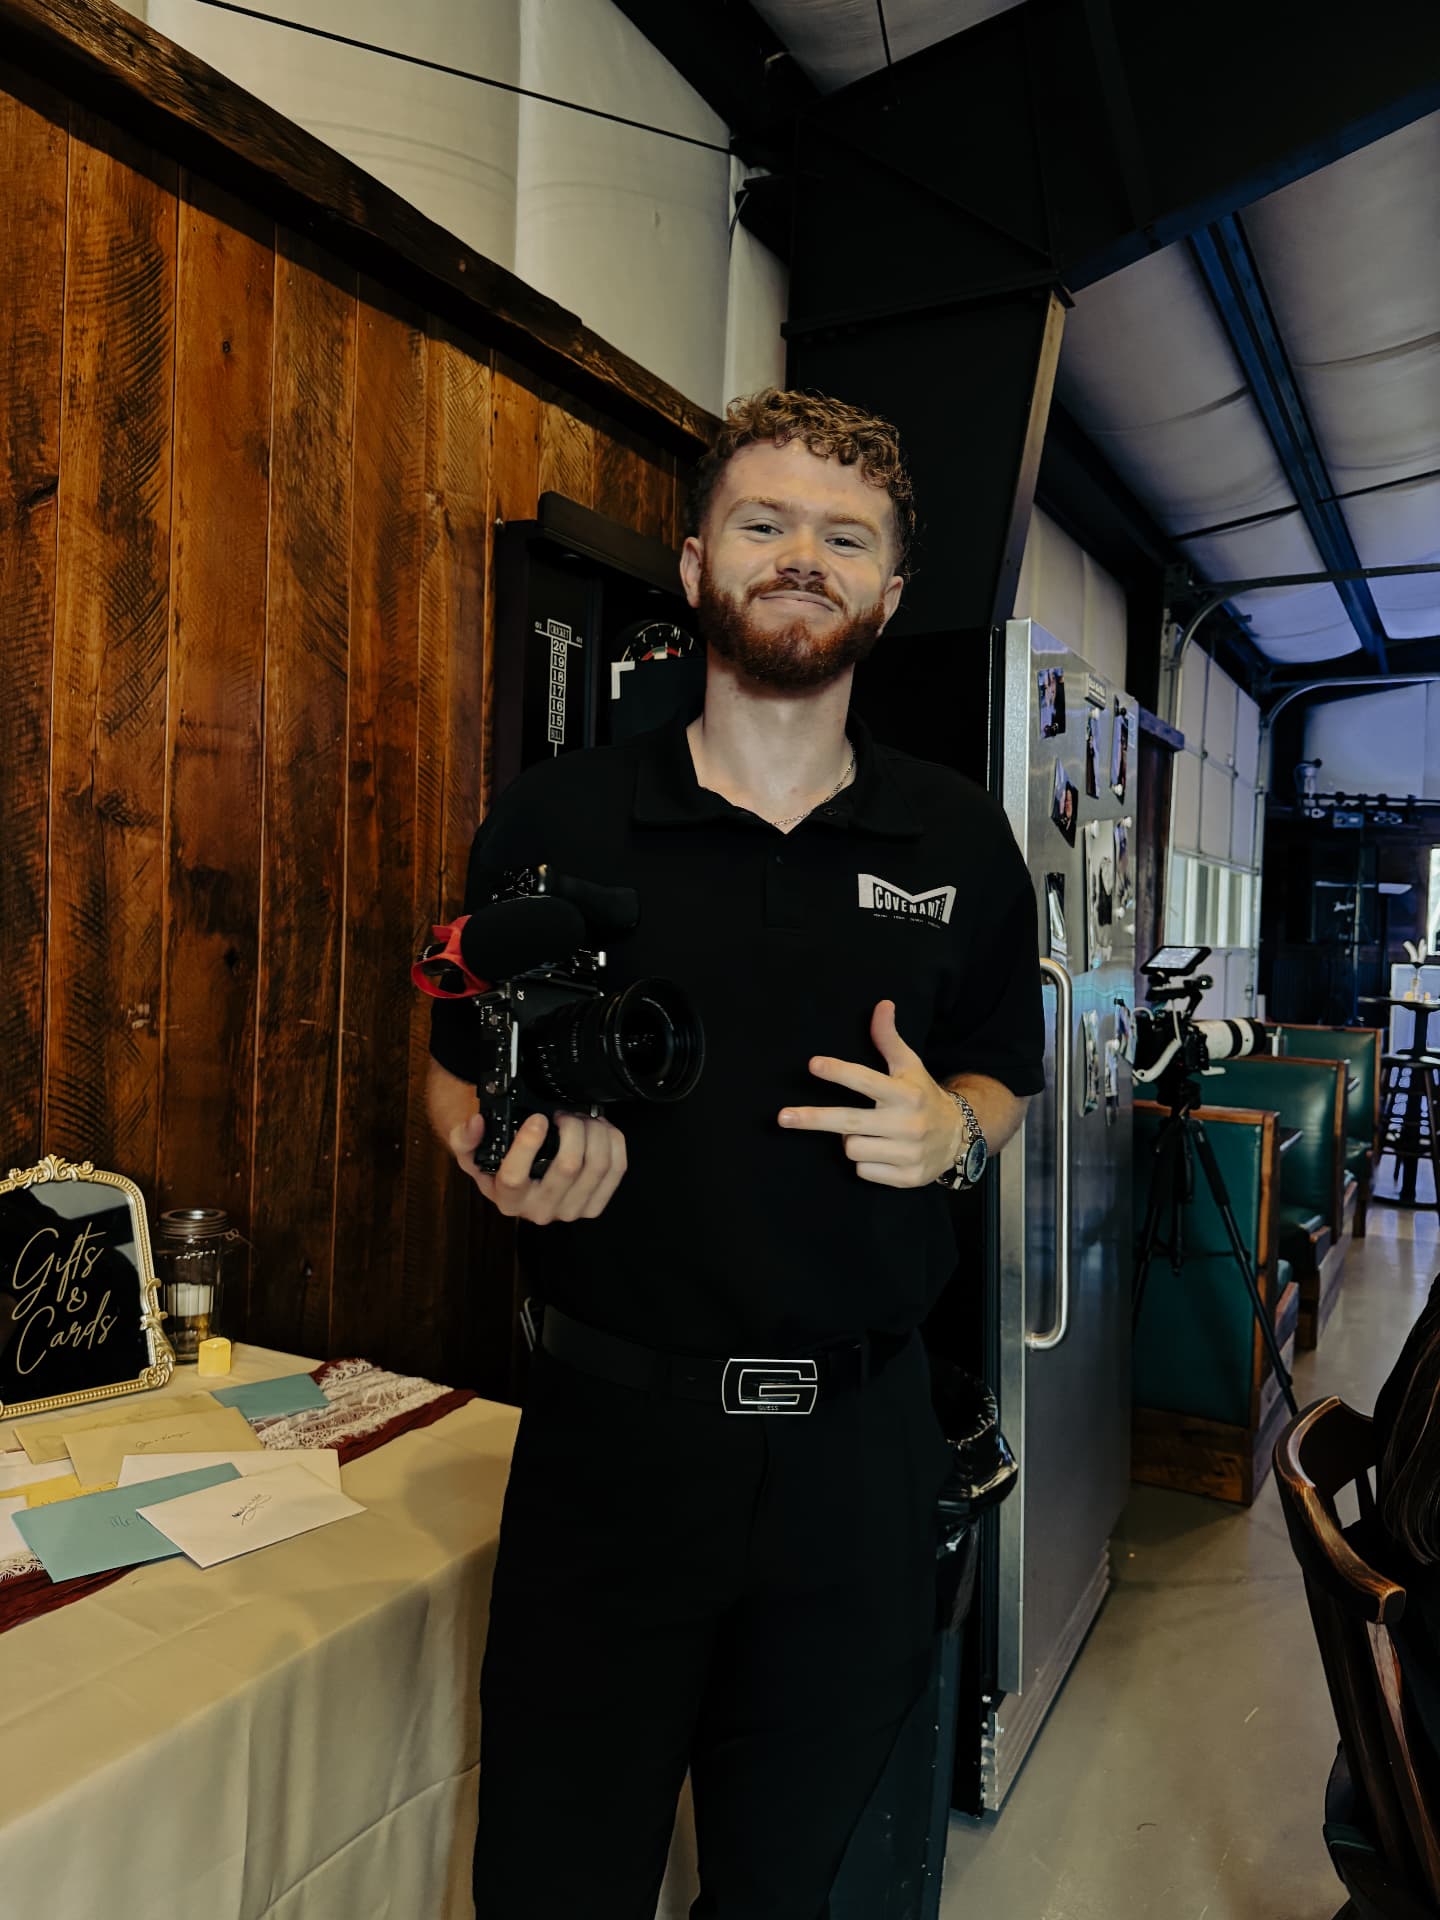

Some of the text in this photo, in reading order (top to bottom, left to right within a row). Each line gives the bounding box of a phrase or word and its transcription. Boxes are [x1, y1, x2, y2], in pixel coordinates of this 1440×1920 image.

[553, 640, 565, 653] 20
[553, 655, 565, 668] 19
[552, 669, 564, 683] 18
[552, 684, 564, 697] 17
[551, 699, 563, 712] 16
[551, 714, 563, 727] 15
[874, 886, 940, 919] COVENANT
[11, 1221, 107, 1321] Gifts
[66, 1286, 87, 1313] &
[16, 1290, 118, 1375] Cards
